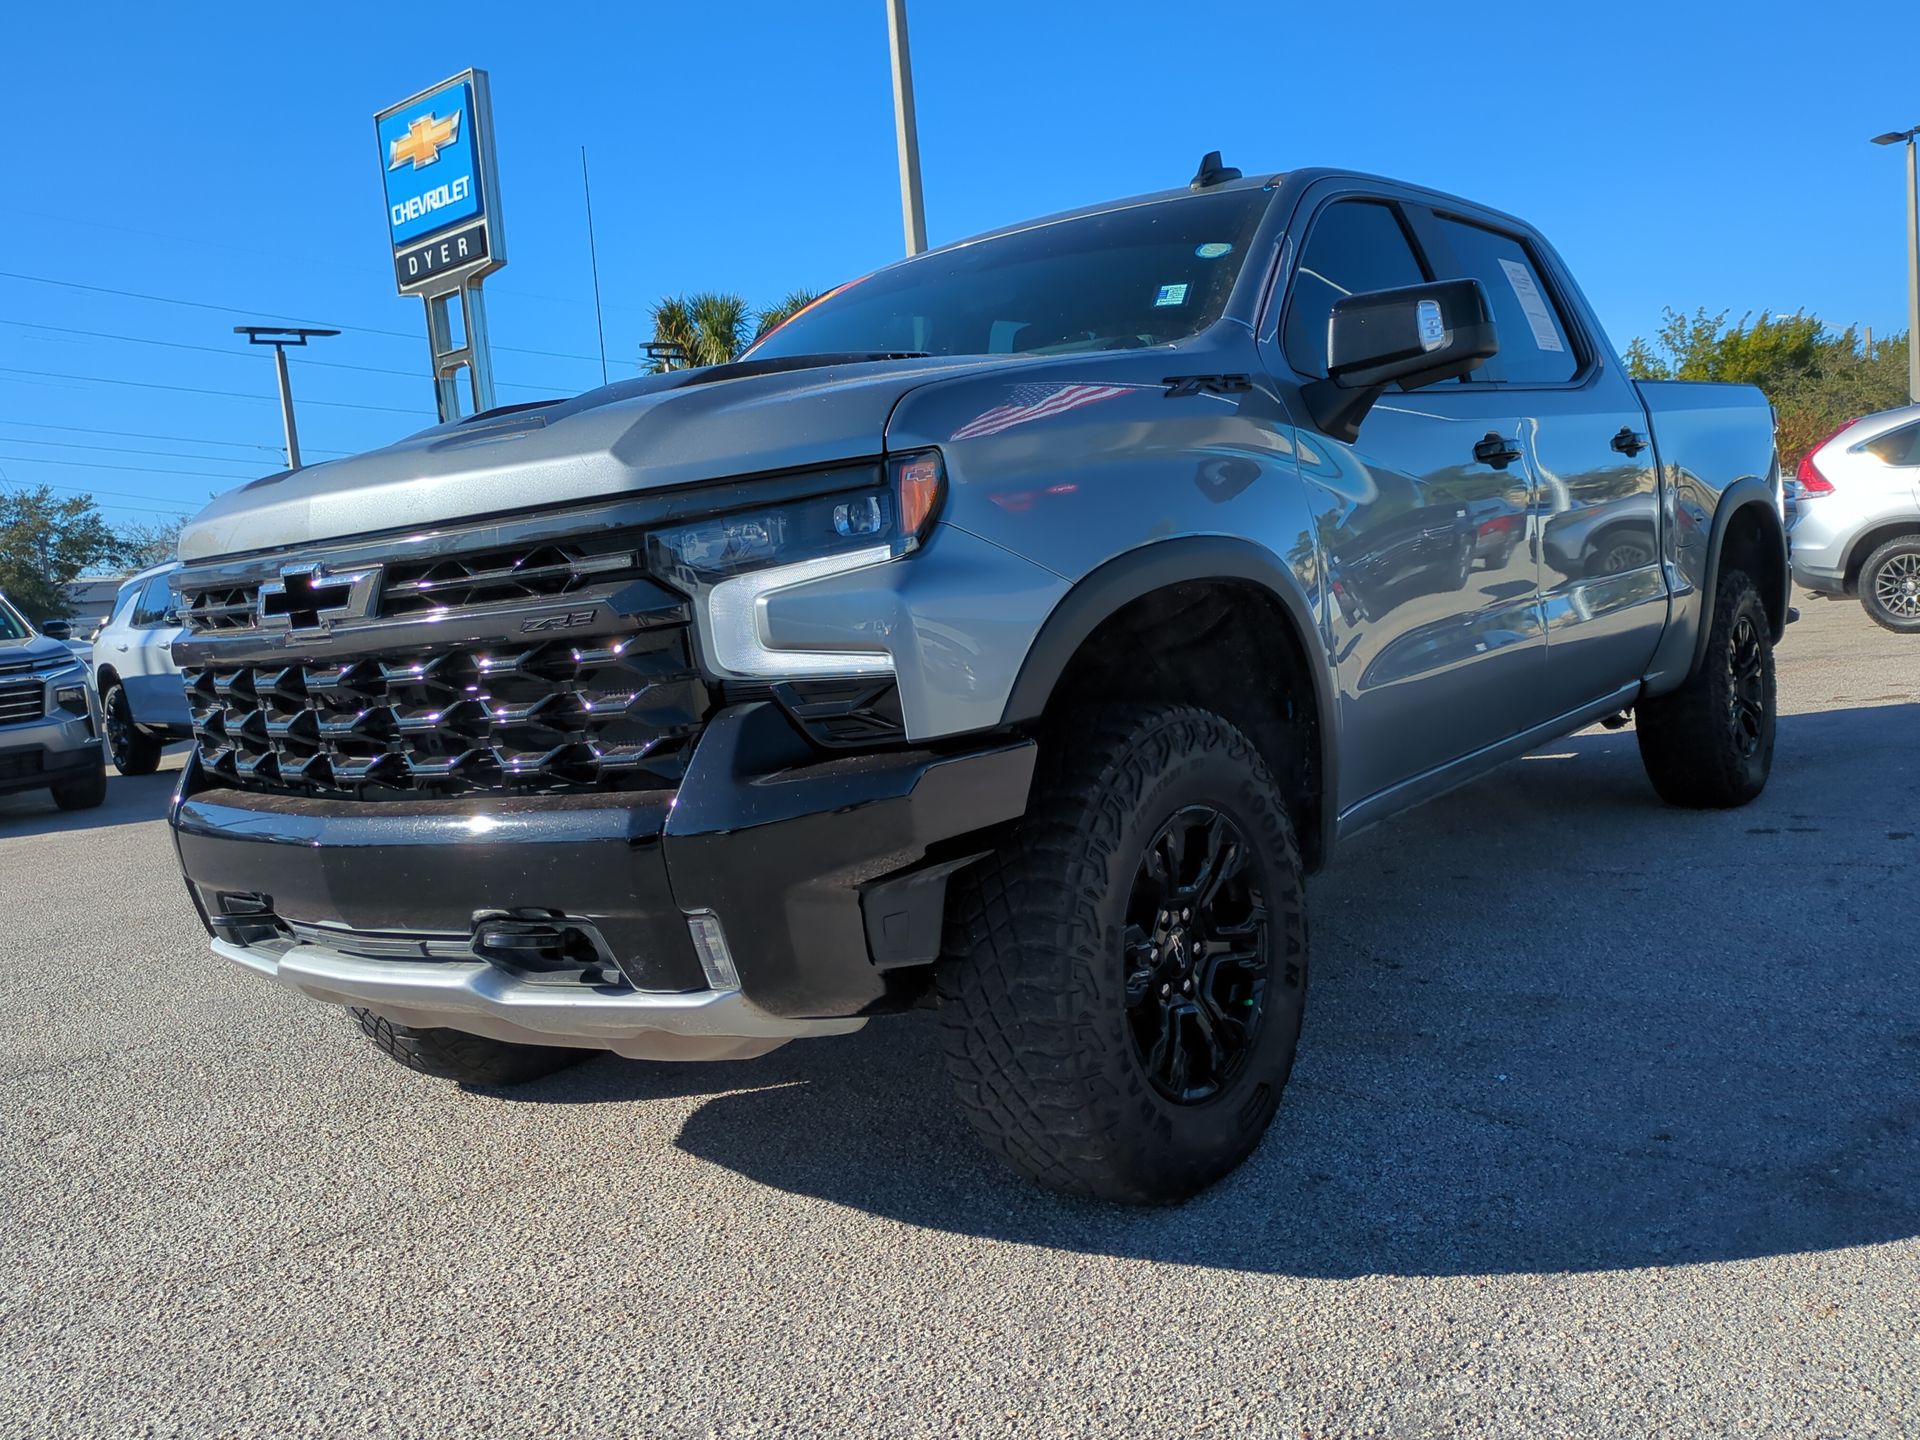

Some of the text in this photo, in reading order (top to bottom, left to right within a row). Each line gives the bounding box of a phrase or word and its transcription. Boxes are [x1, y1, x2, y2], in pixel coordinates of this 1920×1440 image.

[391, 175, 470, 226] CHEVROLET
[408, 237, 468, 275] DYER
[1162, 373, 1252, 398] ZR2
[520, 608, 600, 634] ZR2
